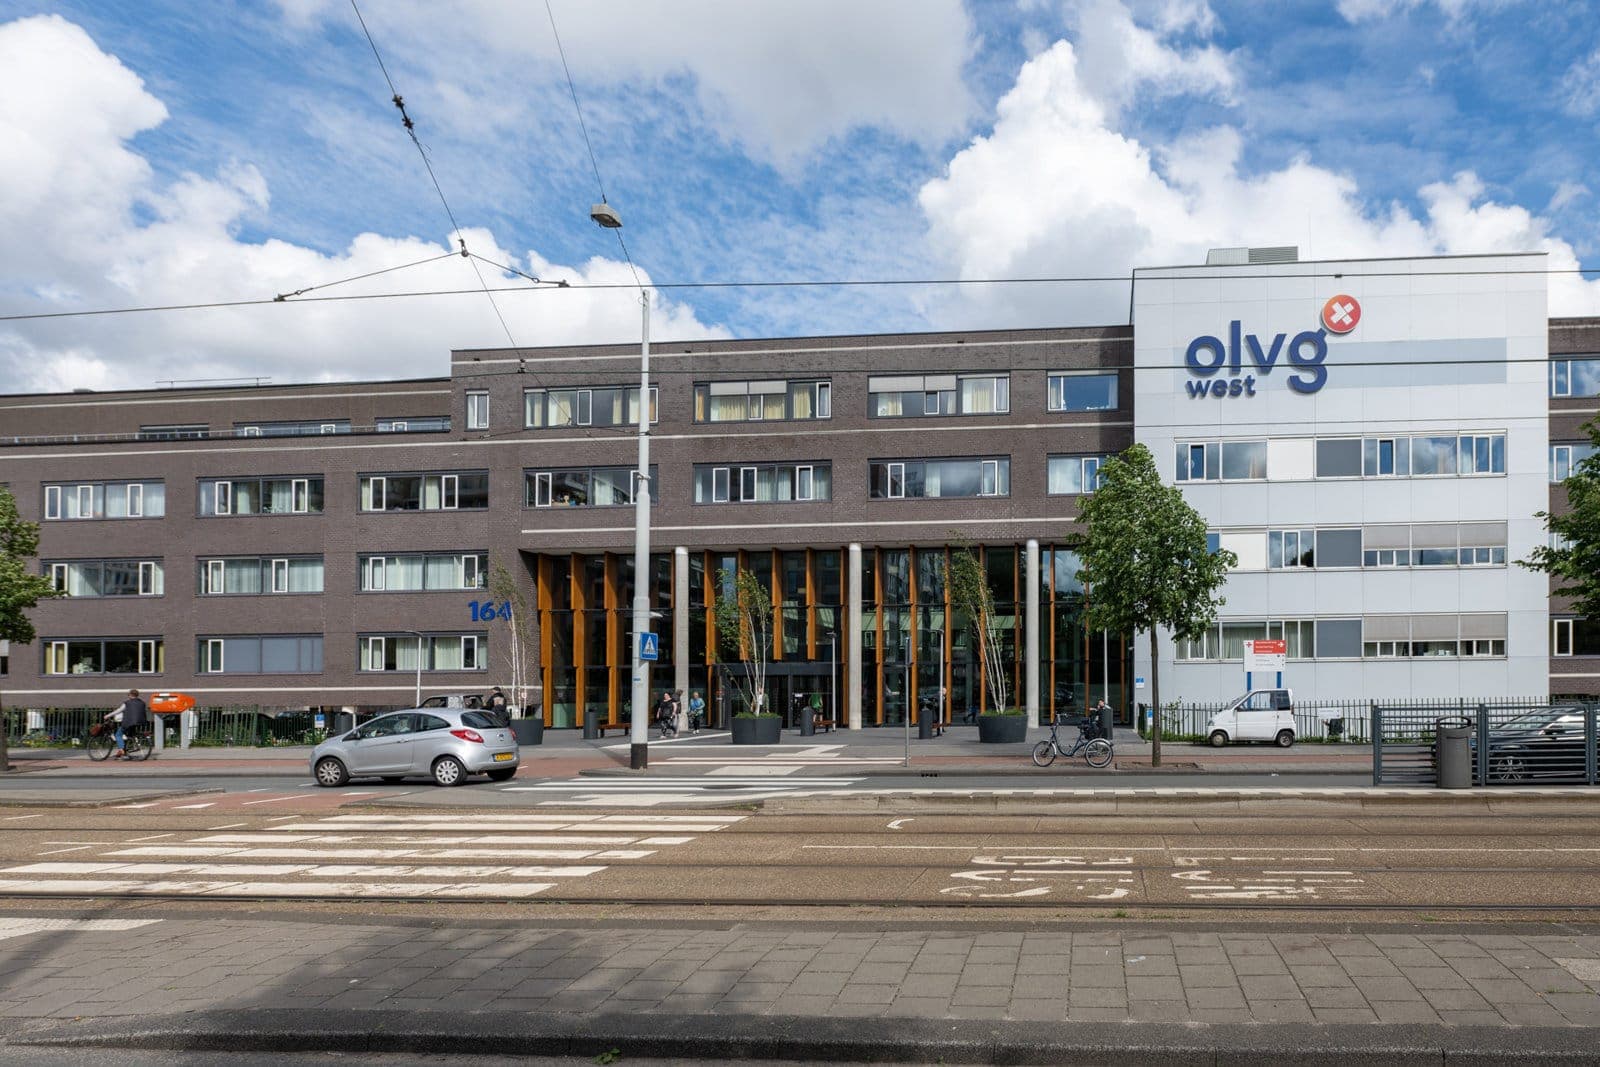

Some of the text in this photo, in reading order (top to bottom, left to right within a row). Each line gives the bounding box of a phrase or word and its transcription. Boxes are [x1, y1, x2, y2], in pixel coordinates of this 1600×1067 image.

[1186, 320, 1328, 394] olvg
[1186, 375, 1256, 399] west
[468, 600, 512, 622] 164
[939, 856, 1134, 900] BUS
